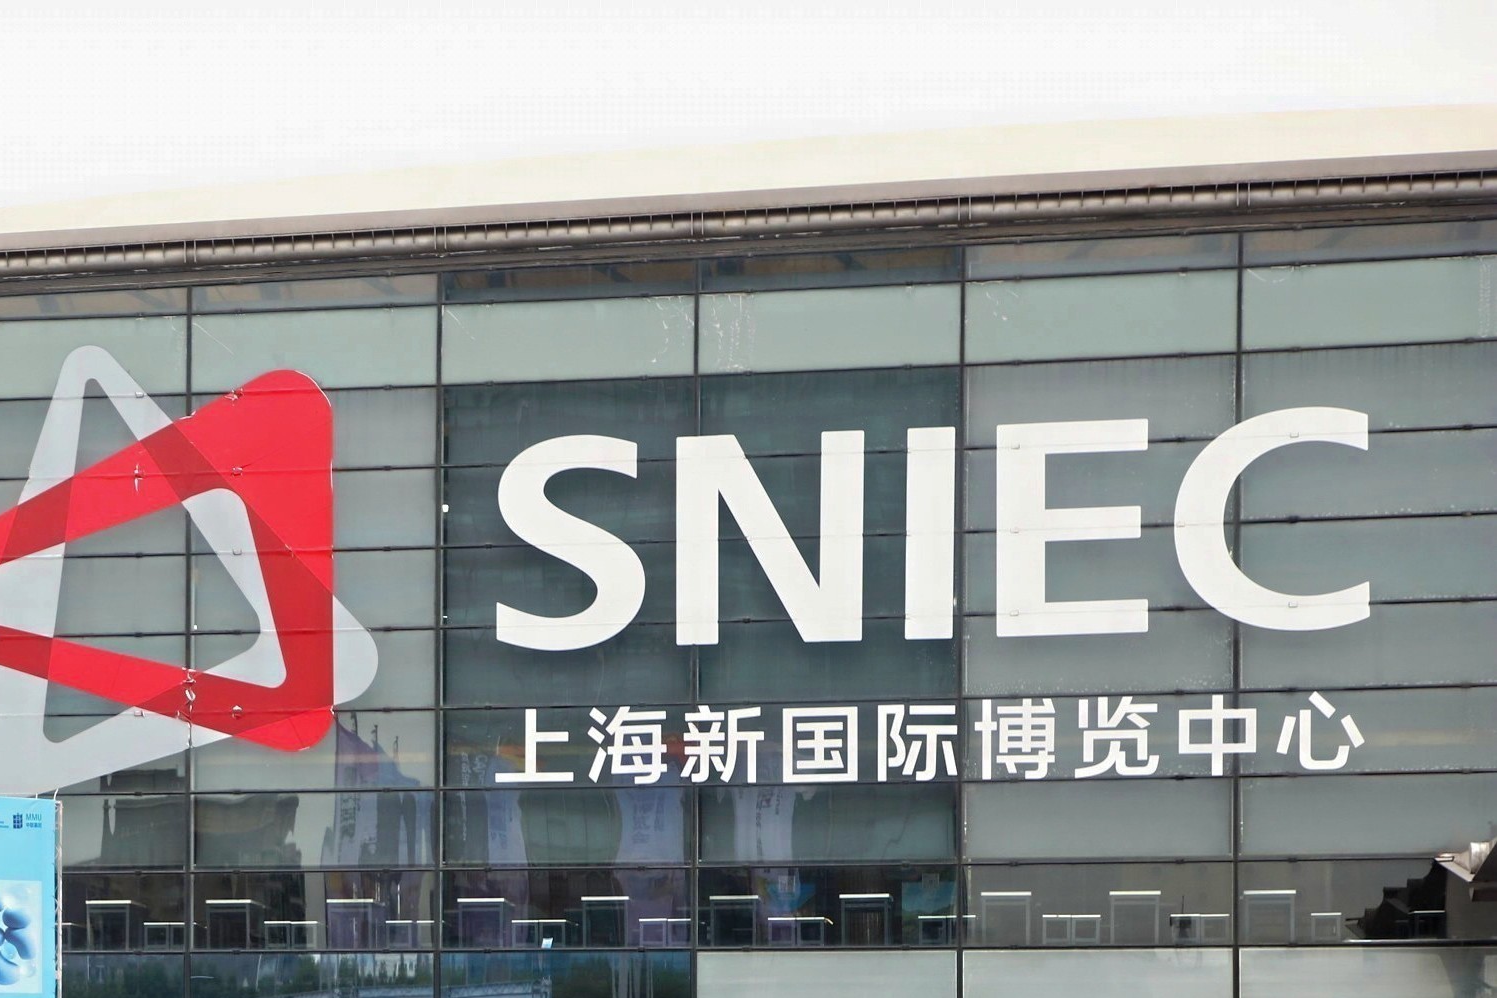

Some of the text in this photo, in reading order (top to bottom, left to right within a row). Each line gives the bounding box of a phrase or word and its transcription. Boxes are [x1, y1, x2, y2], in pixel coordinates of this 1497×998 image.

[496, 405, 1371, 651] SNIEC
[494, 690, 1366, 784] 上海新国际博览中心
